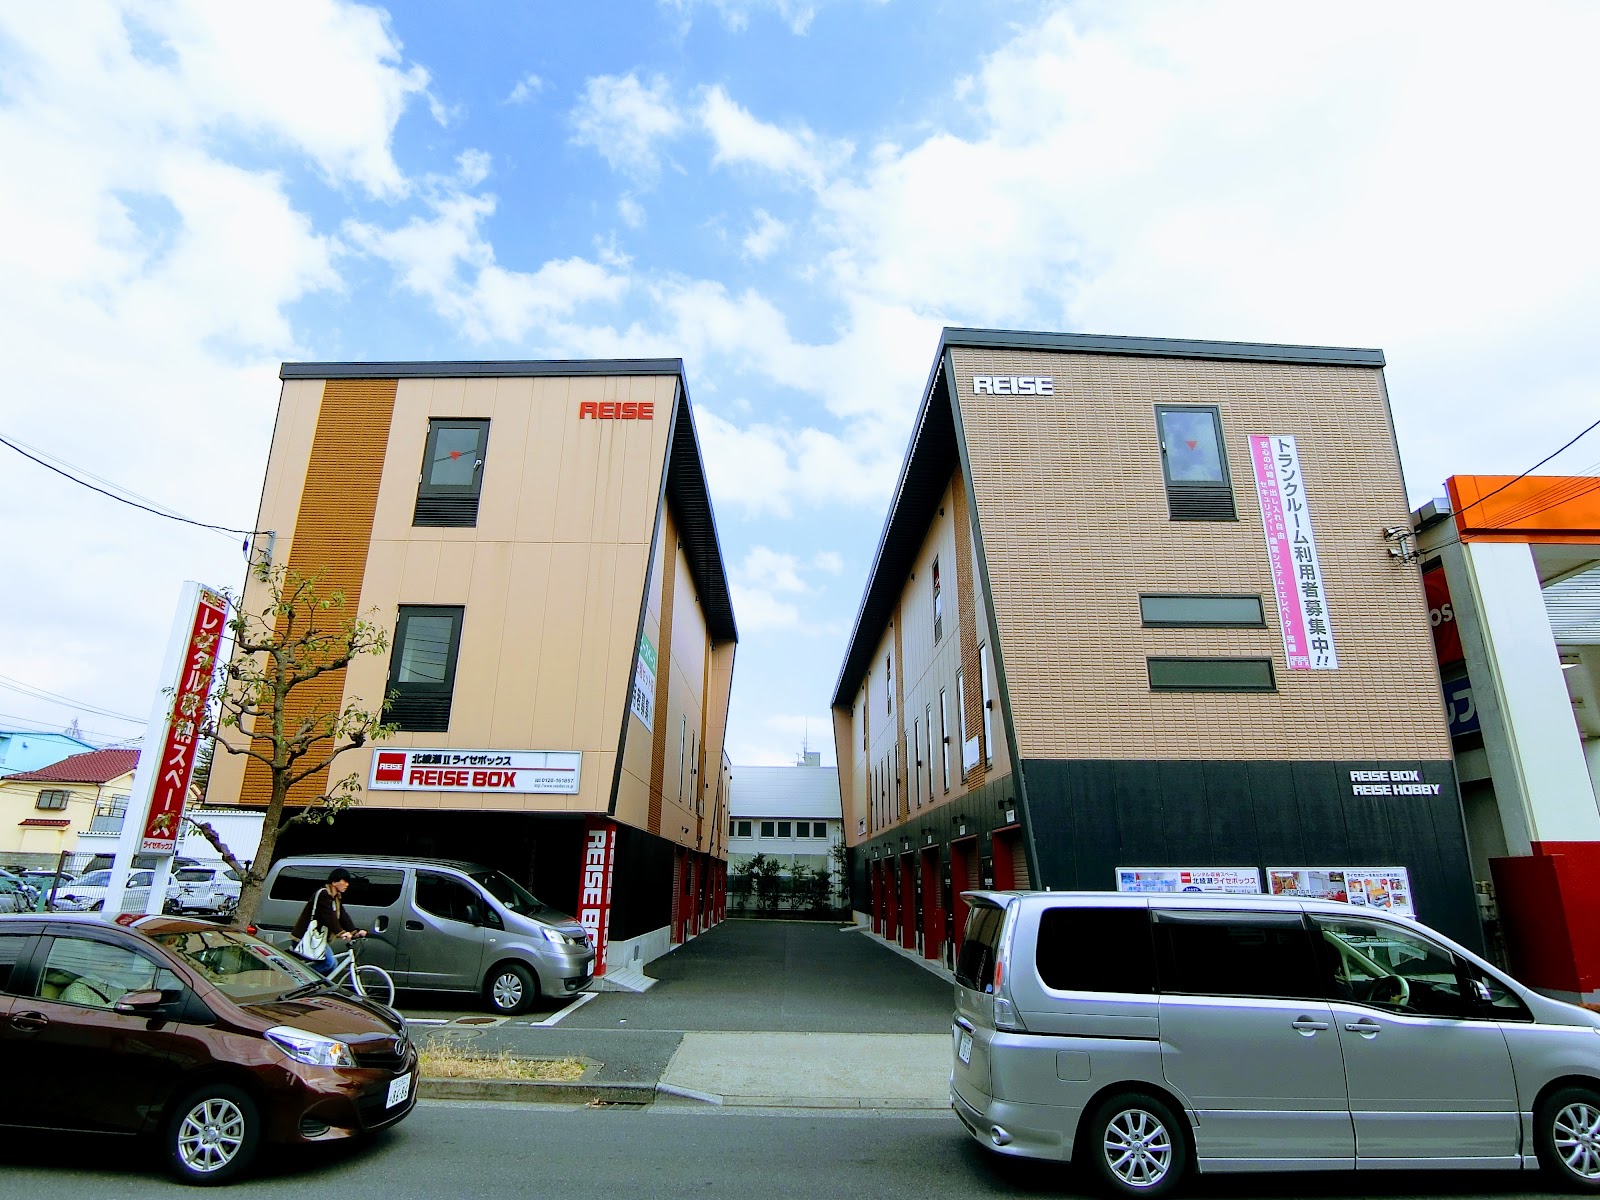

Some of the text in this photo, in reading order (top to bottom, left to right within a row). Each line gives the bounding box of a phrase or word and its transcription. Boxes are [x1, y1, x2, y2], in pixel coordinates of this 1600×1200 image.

[973, 376, 1054, 396] REISE
[579, 402, 654, 420] REISE
[409, 770, 517, 787] REISE BOX
[1350, 770, 1420, 782] REISE BOX
[1352, 784, 1440, 796] REISE HOBBY
[143, 841, 173, 851] ライゼボックス
[581, 830, 607, 967] REISE BO
